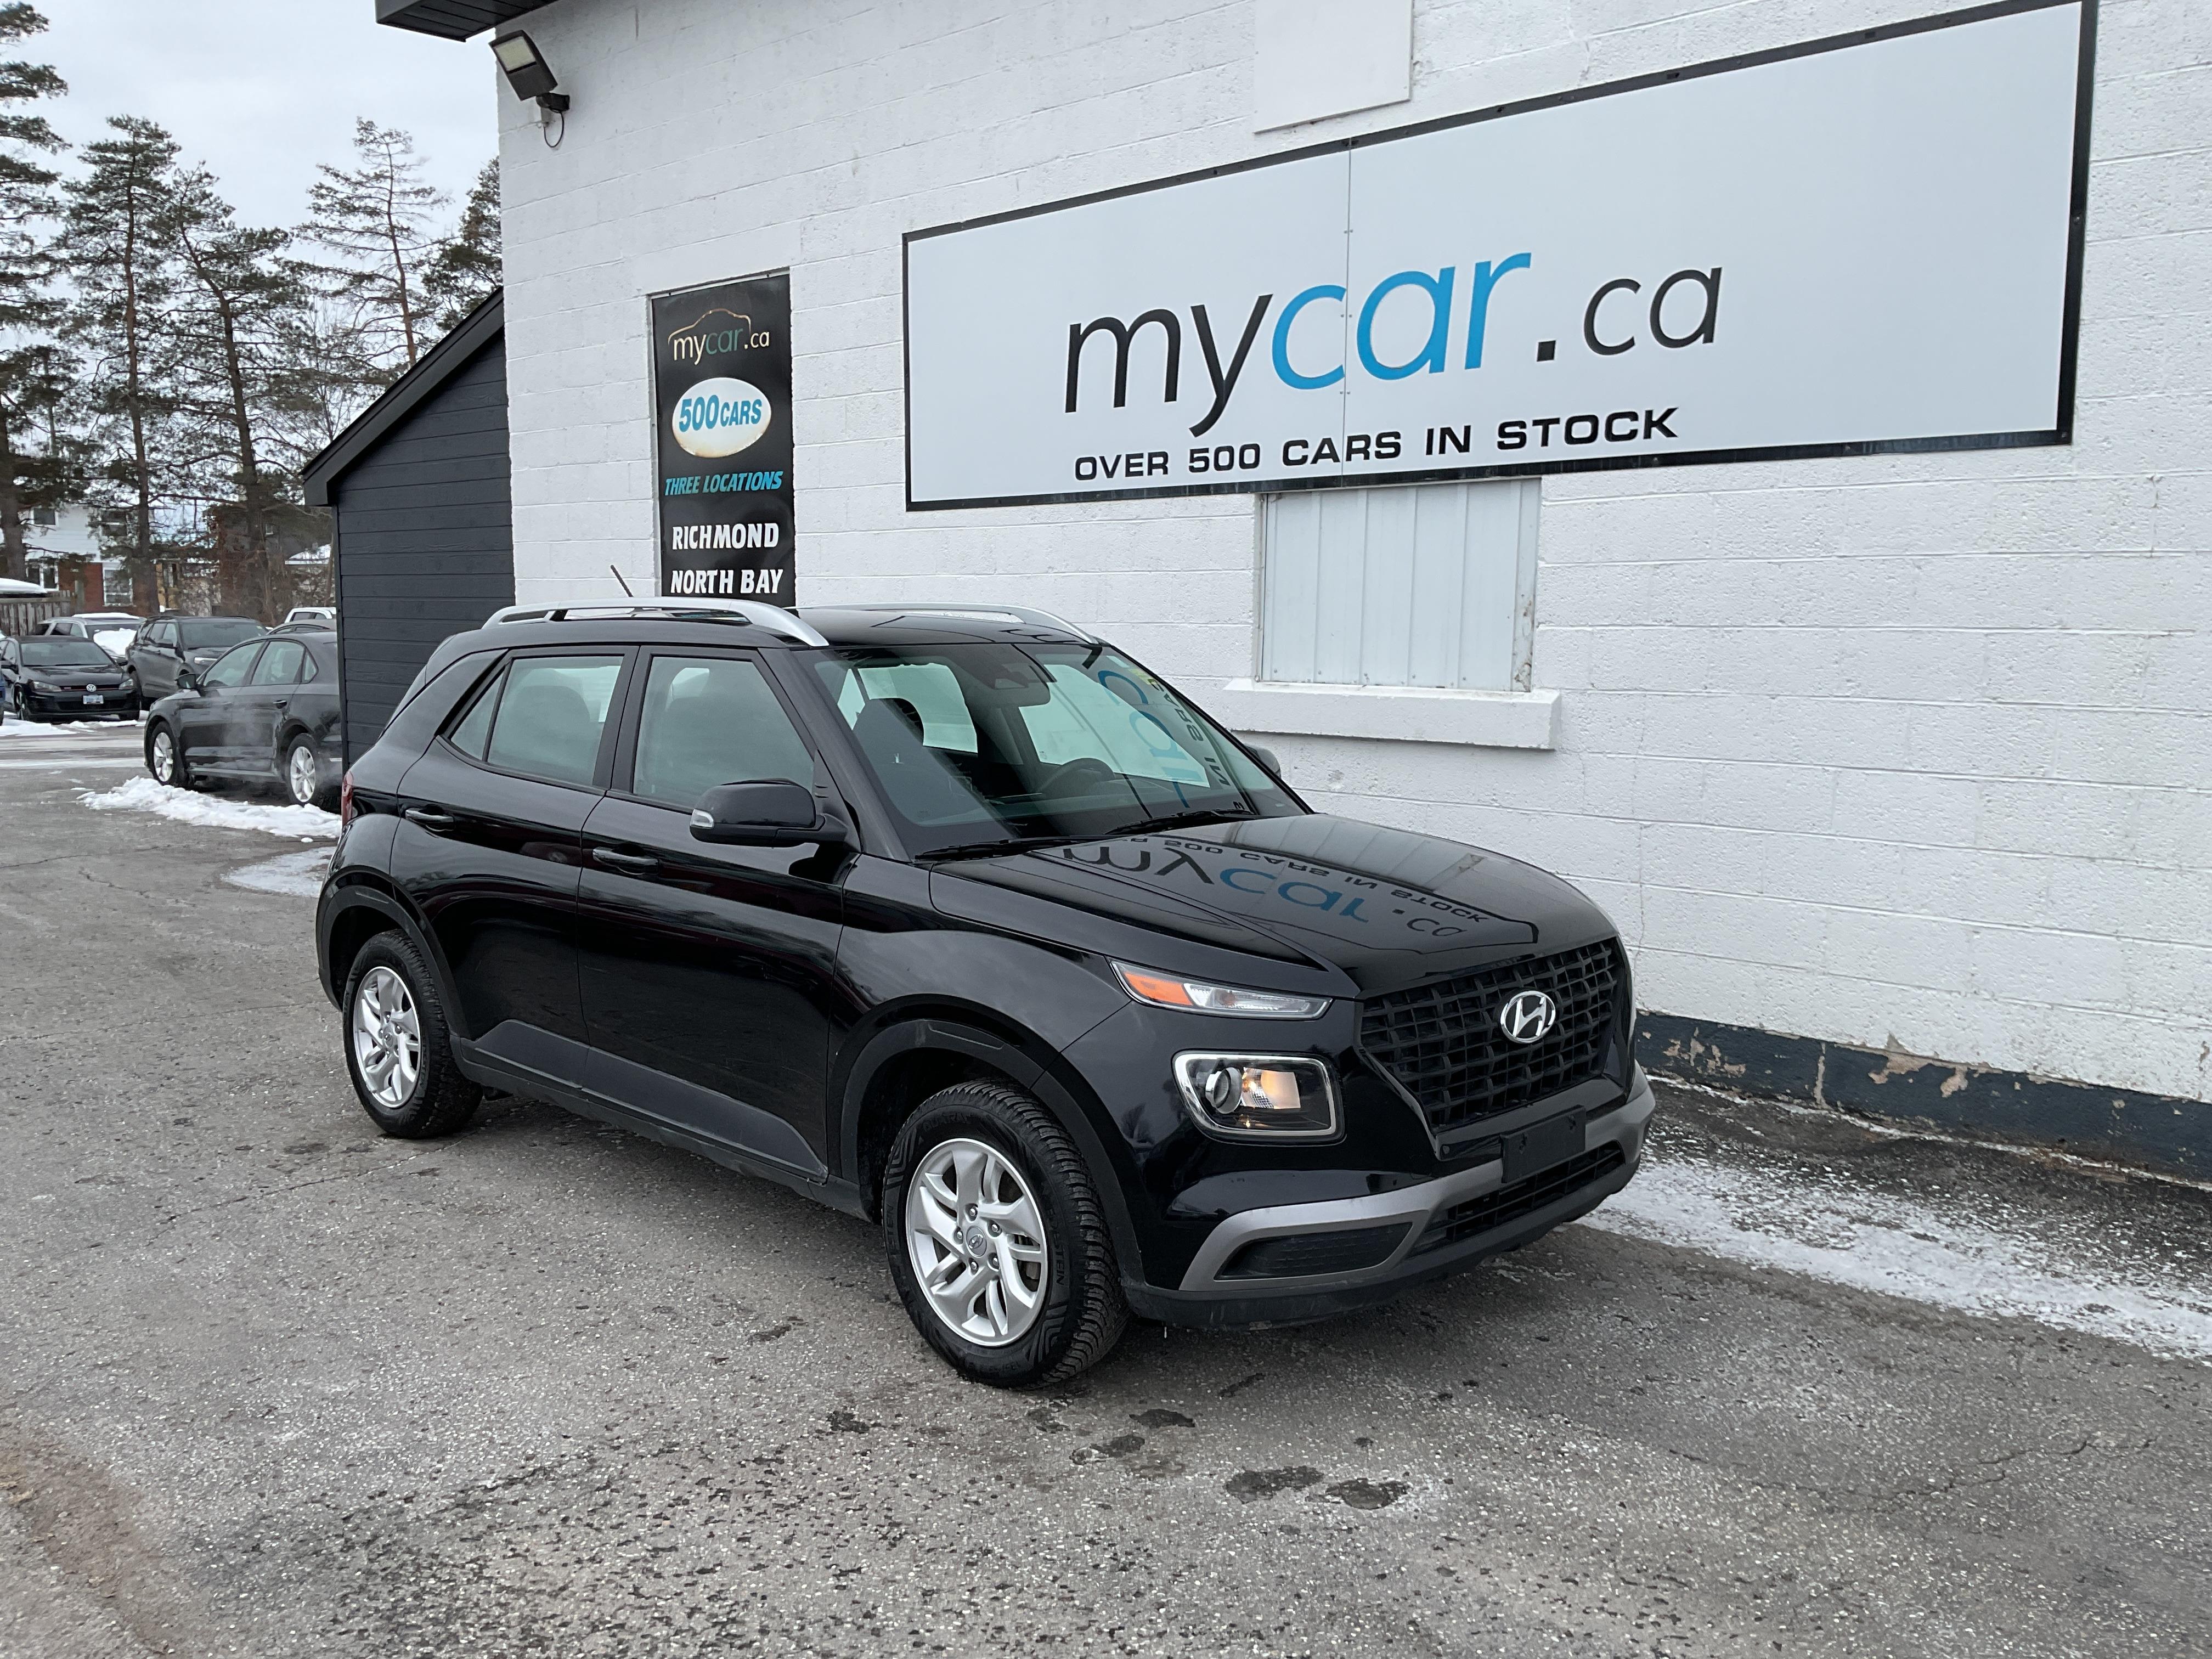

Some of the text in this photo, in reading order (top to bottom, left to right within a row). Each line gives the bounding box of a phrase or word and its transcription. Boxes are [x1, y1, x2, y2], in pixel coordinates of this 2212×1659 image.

[1074, 407, 1679, 481] OVER 500 CARS IN STOCK
[664, 469, 785, 496] THREE LOCATIONS
[672, 522, 780, 550] RICHMOND
[670, 569, 784, 594] NORTH BAY
